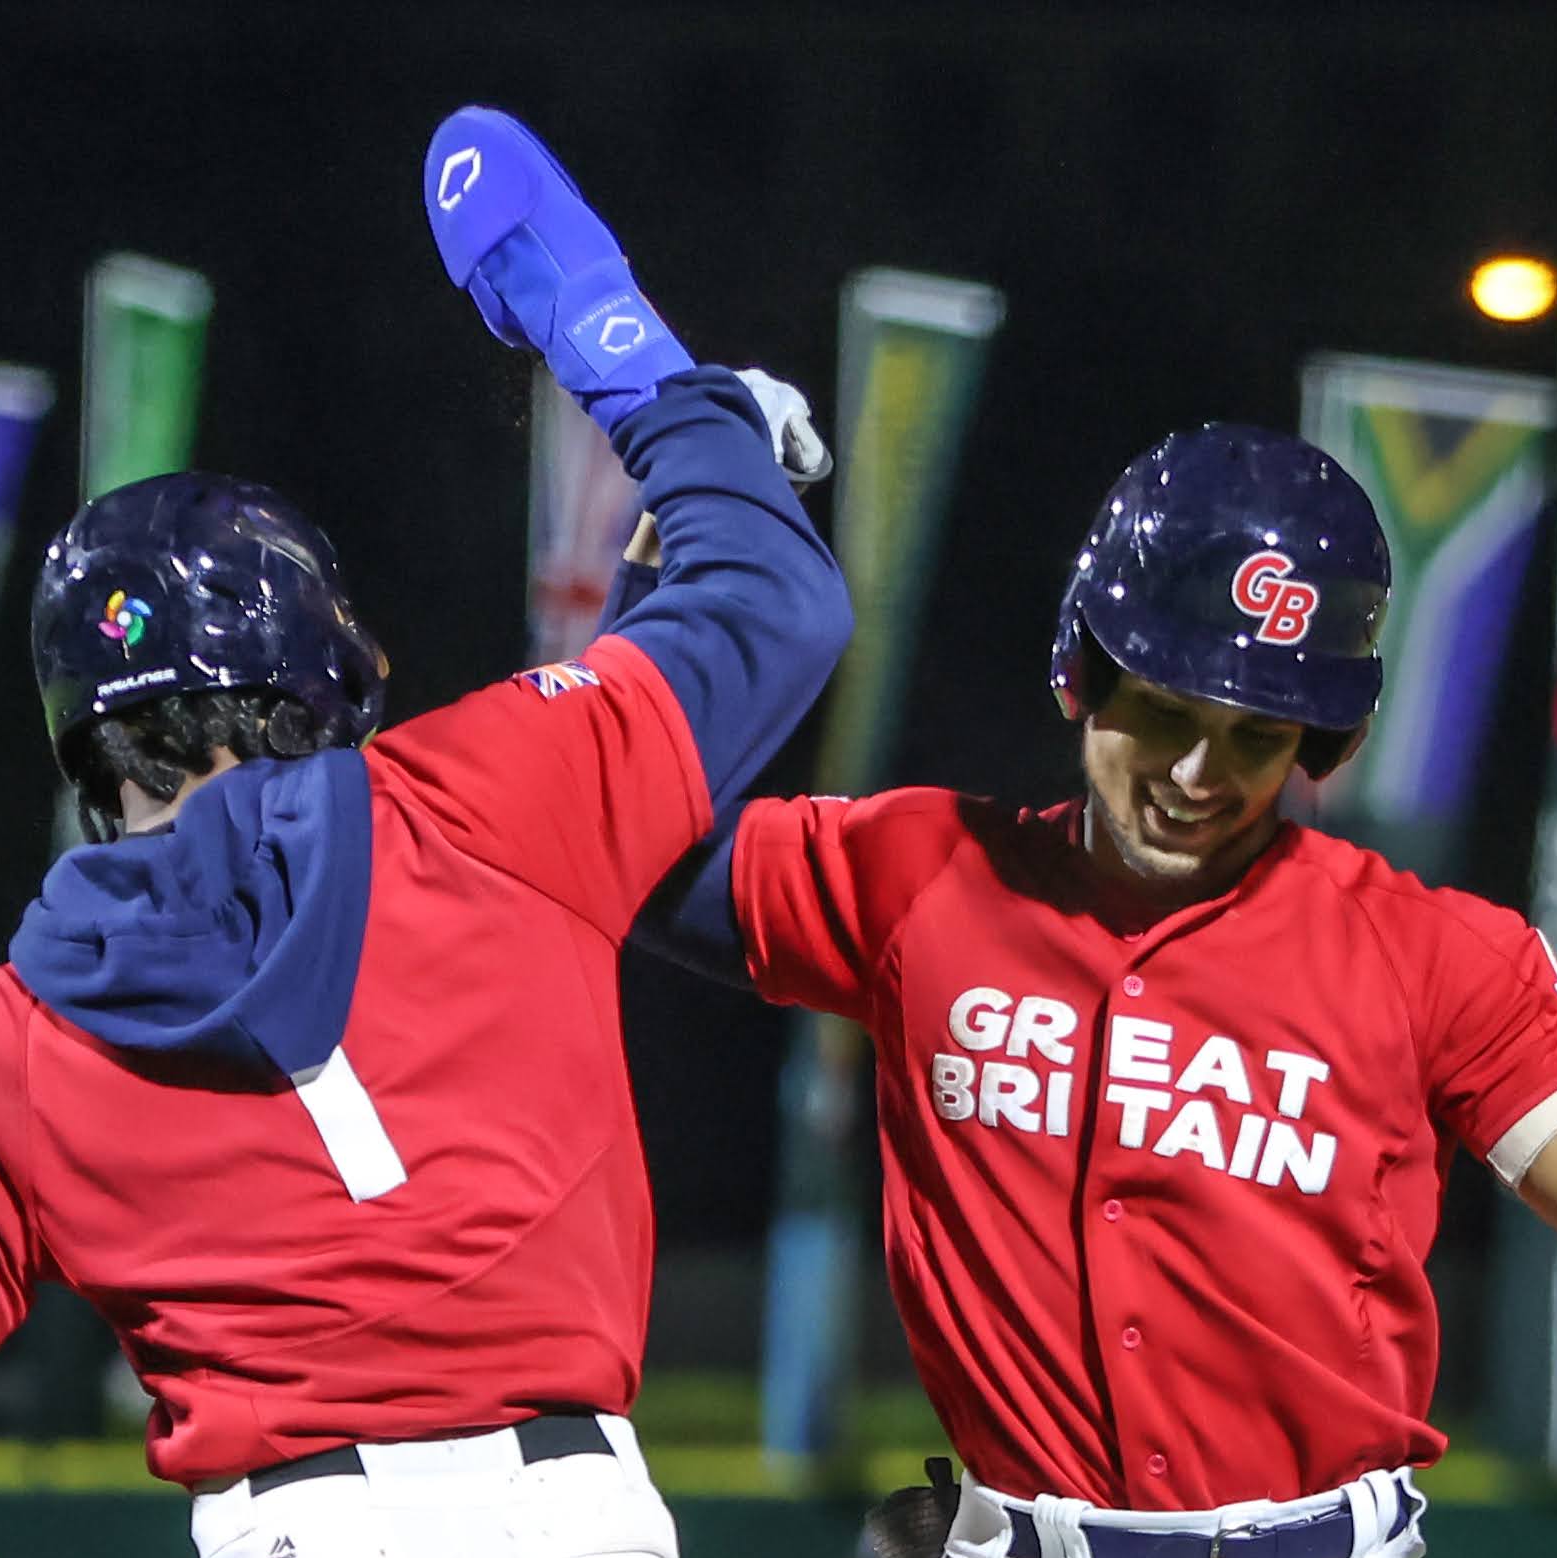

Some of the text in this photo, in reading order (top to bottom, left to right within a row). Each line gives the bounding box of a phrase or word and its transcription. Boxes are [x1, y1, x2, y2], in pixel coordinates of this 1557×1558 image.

[1231, 551, 1318, 645] GB
[948, 986, 1331, 1120] GREAT
[931, 1052, 1337, 1195] BRITAIN
